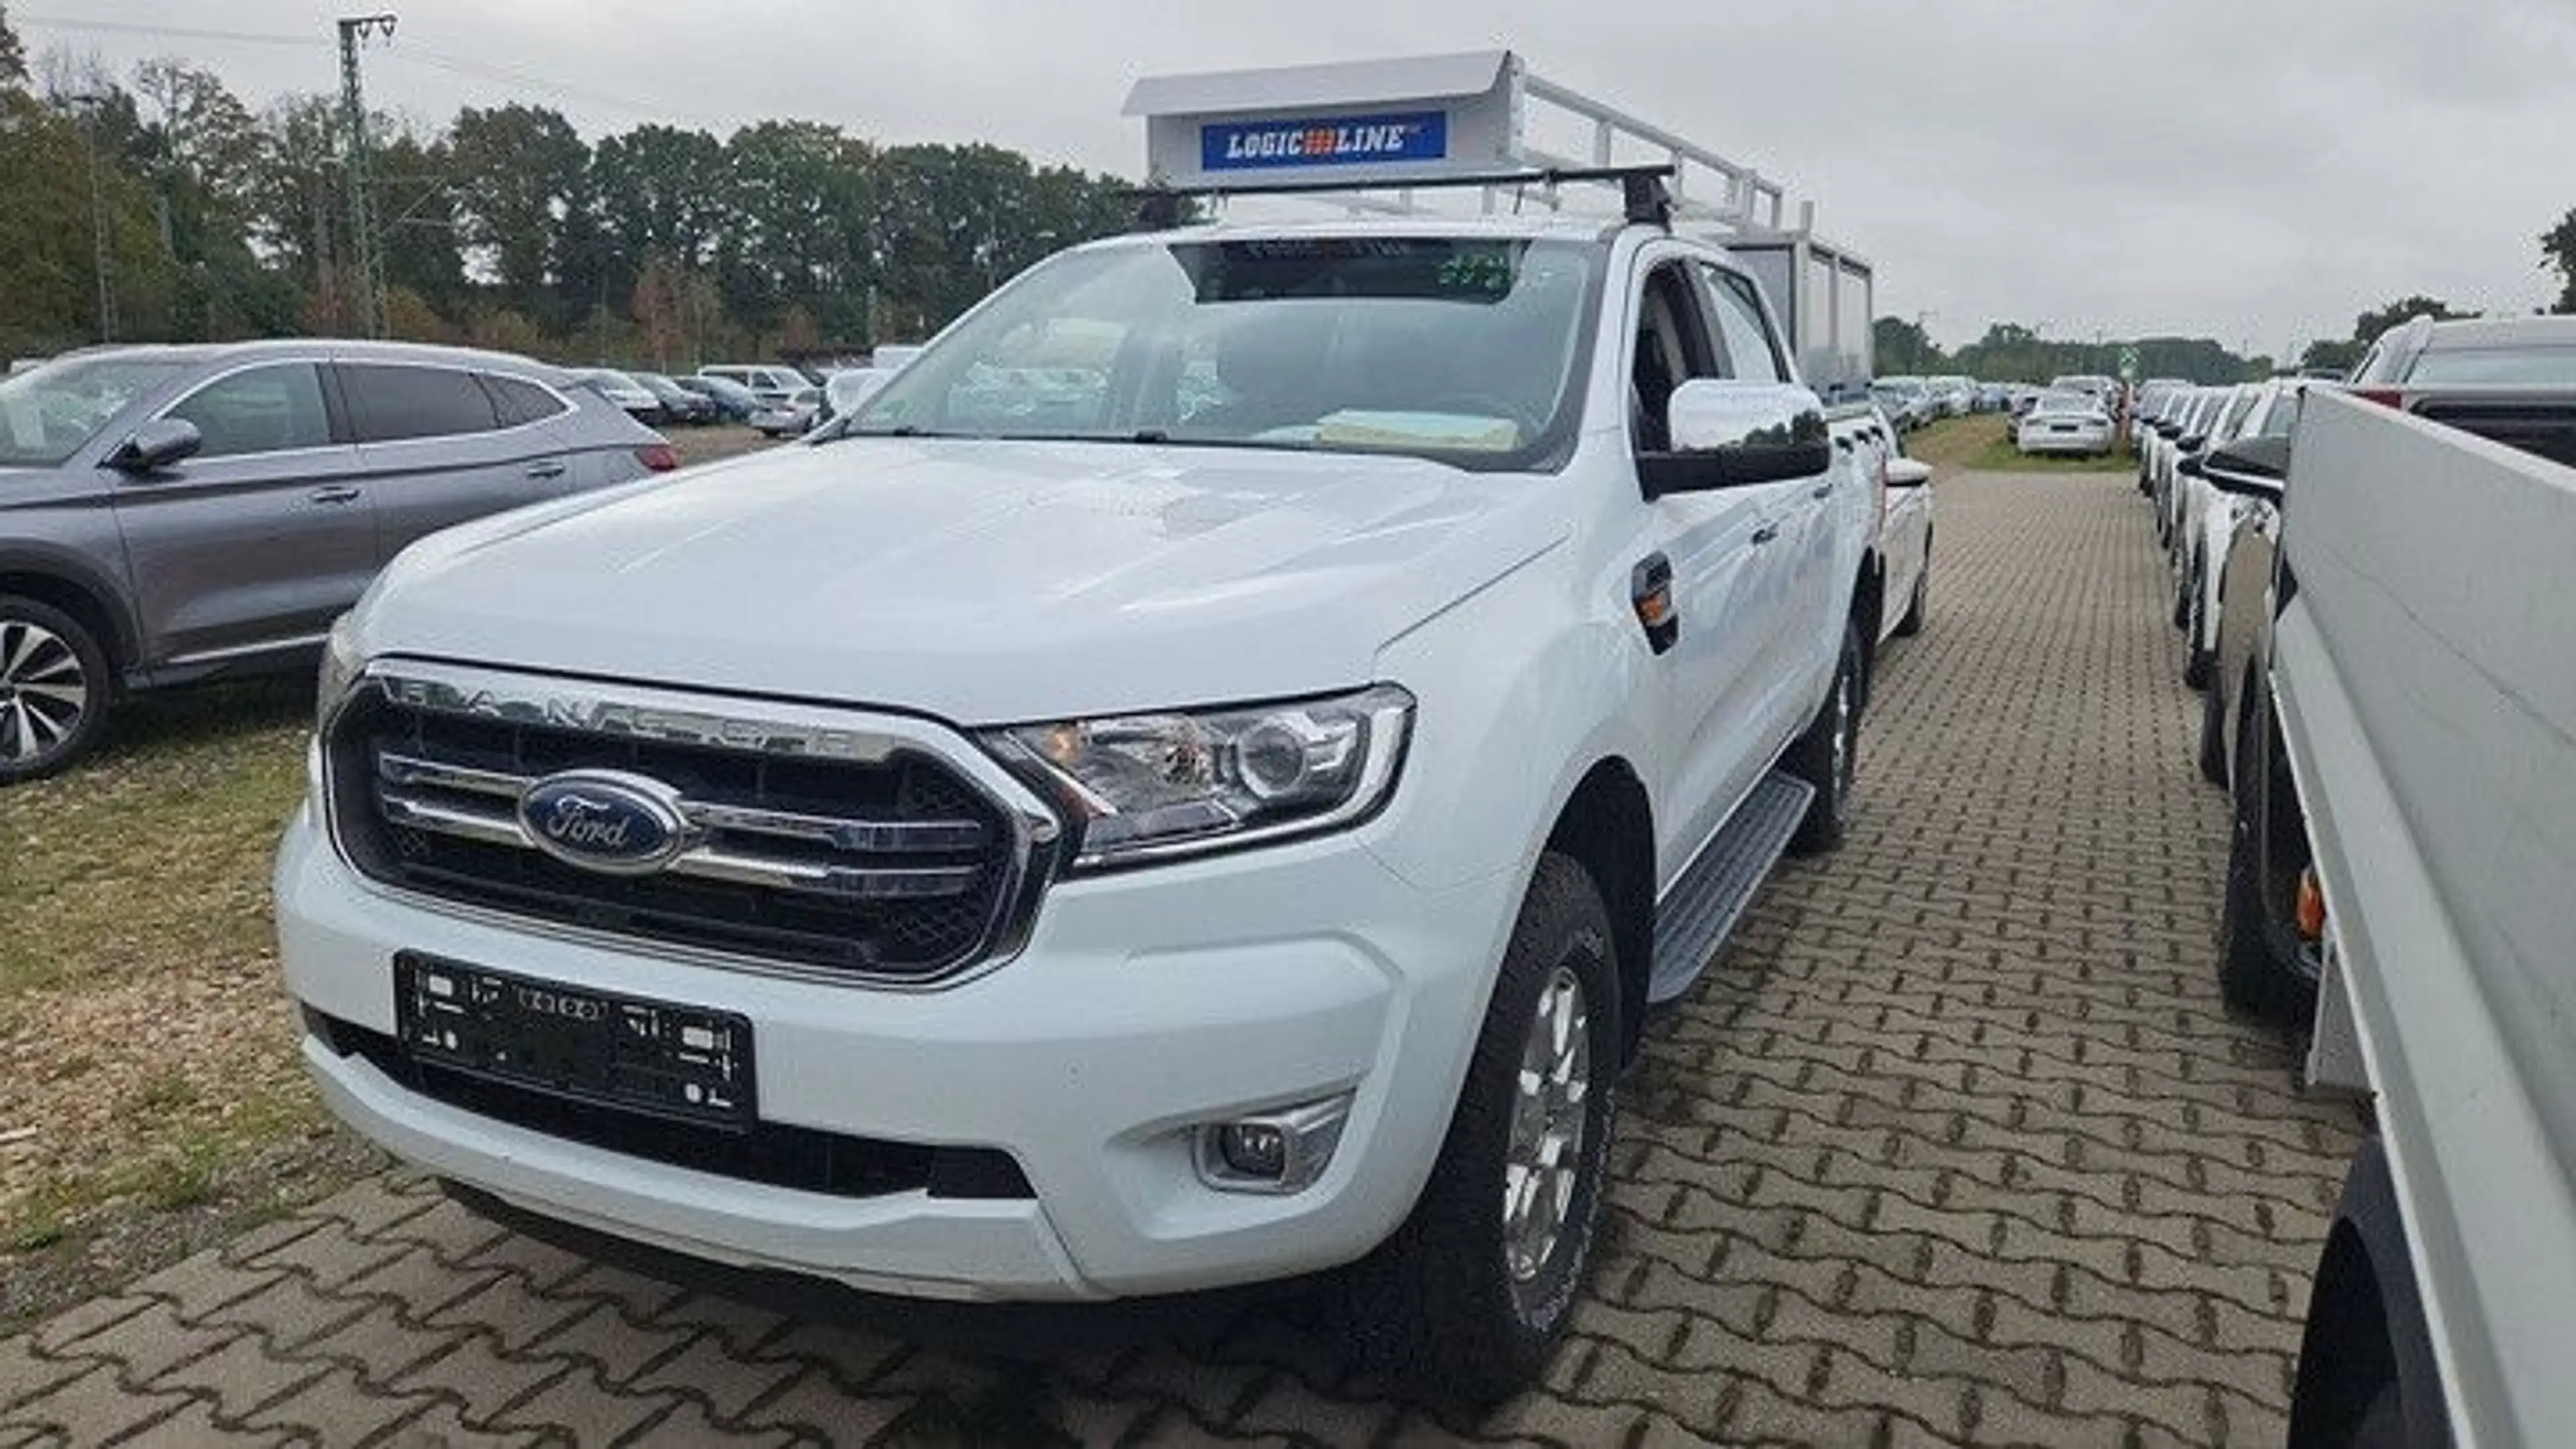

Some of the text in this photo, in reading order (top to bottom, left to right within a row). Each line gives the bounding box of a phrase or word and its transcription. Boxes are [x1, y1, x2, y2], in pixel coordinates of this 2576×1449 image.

[1226, 125, 1406, 158] LOGIC LINE
[547, 794, 631, 847] Ford
